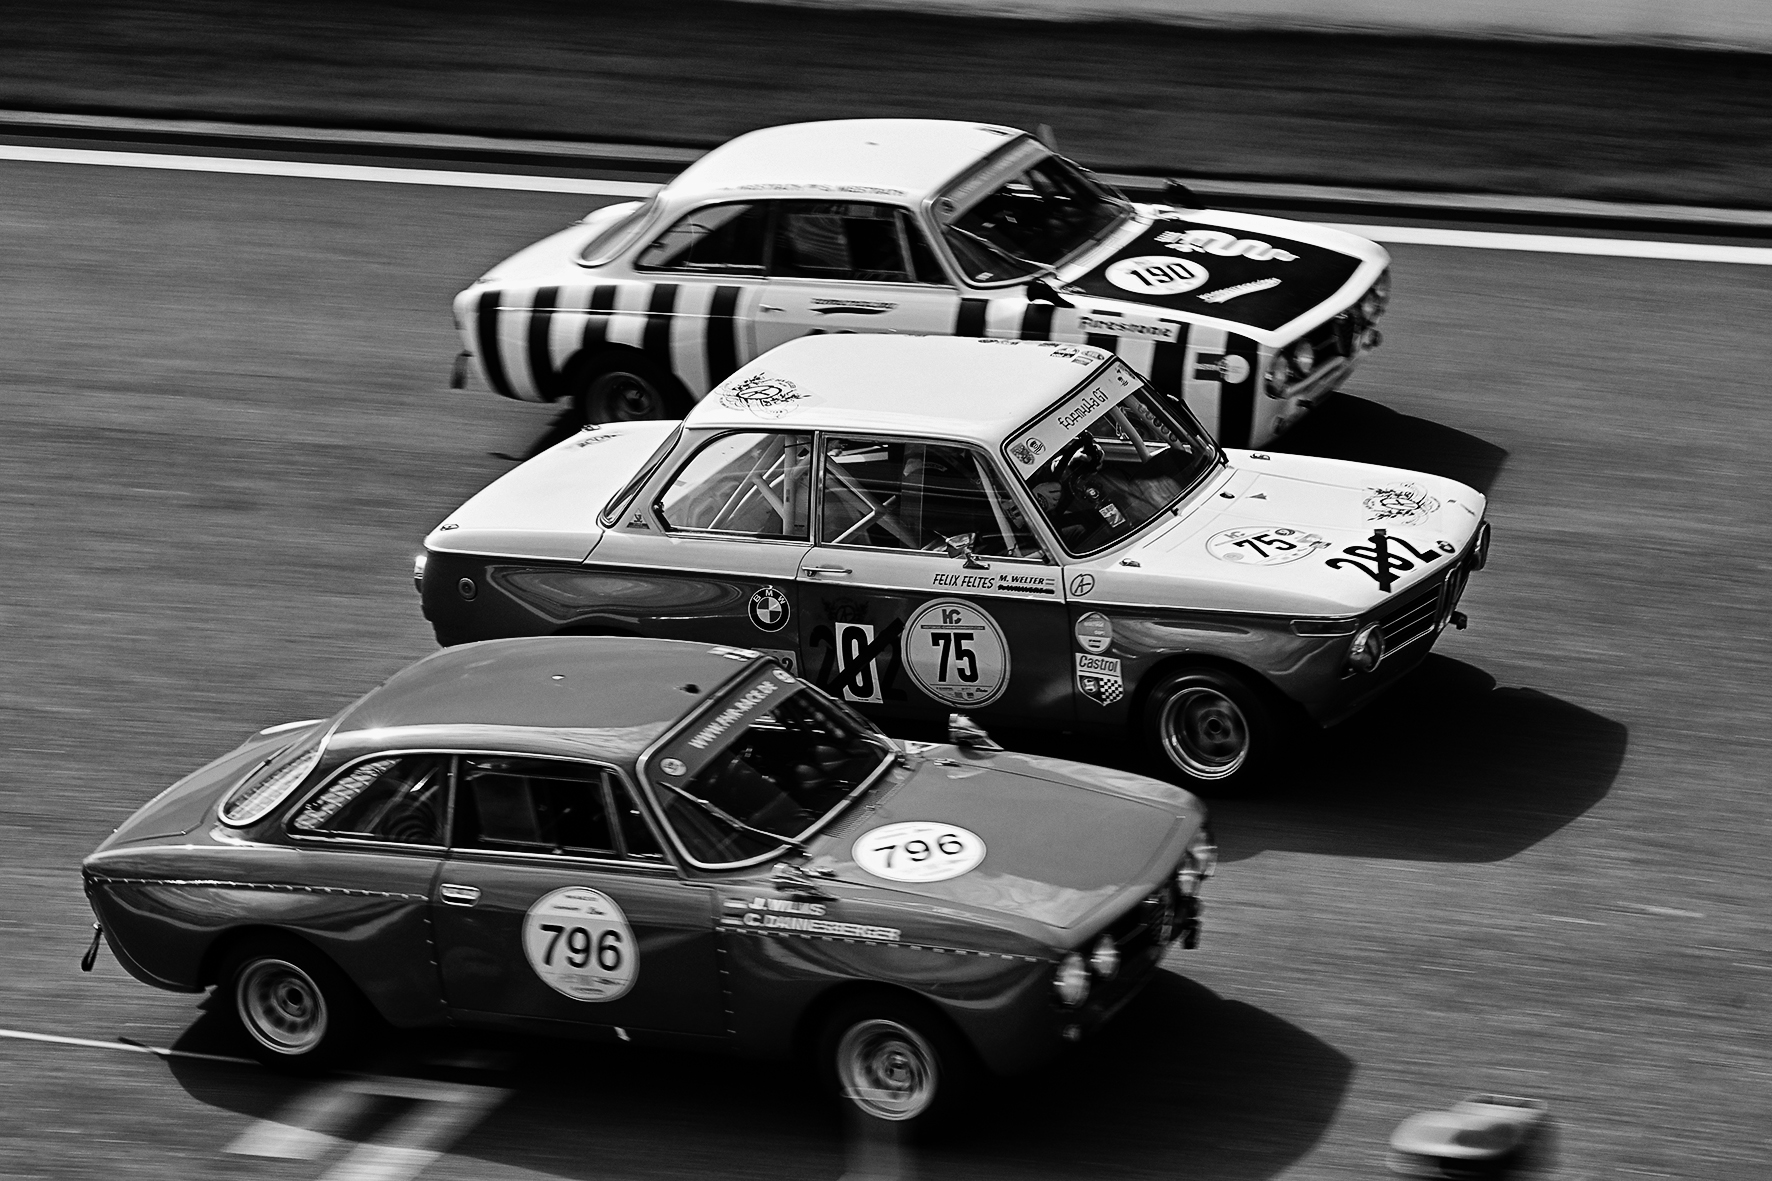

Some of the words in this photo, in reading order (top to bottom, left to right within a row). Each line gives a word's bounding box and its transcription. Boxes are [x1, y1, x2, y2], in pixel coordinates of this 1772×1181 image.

[1128, 263, 1195, 287] 190
[1232, 533, 1297, 558] 75
[932, 573, 960, 587] FELIX
[961, 576, 995, 589] FELTES
[1011, 575, 1045, 585] WELTER
[753, 590, 786, 604] BMW
[931, 632, 979, 683] 75
[1080, 655, 1118, 672] Castrol
[872, 833, 963, 868] 796
[539, 923, 622, 972] 796
